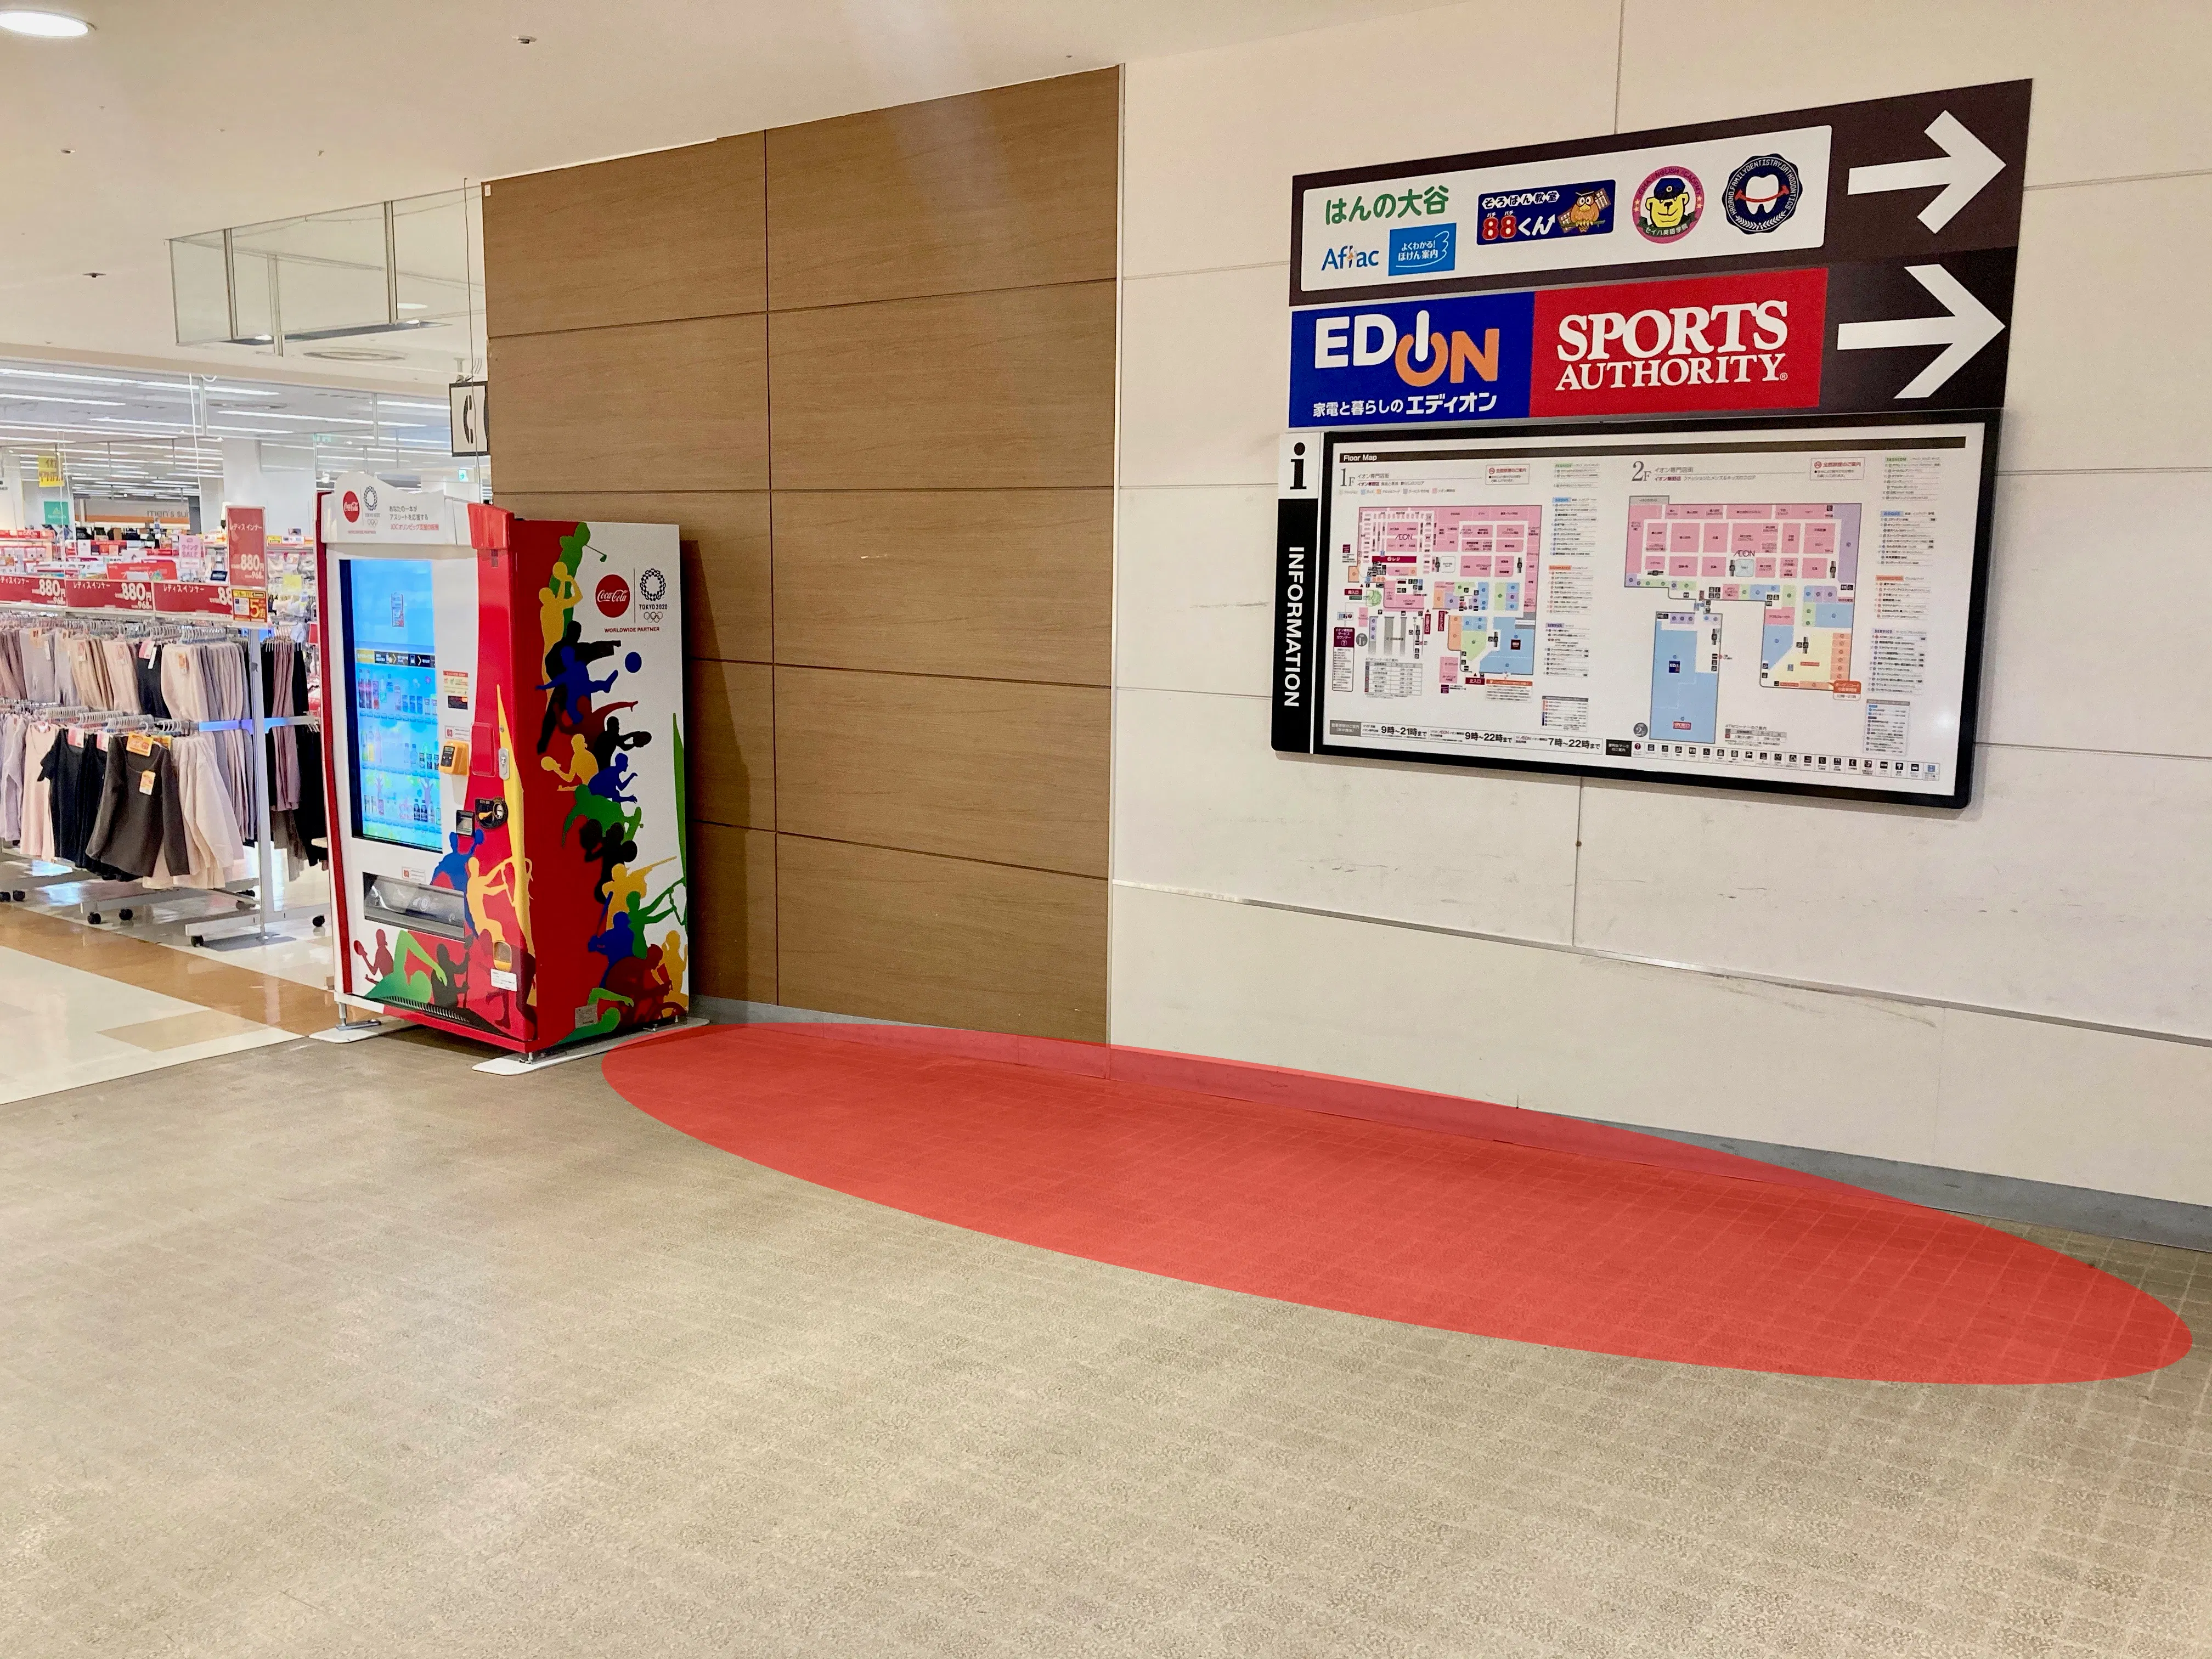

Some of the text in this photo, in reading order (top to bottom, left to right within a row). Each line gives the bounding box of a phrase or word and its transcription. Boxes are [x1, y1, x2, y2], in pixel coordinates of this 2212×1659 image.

[1325, 185, 1449, 225] はんの大谷
[1484, 192, 1558, 208] そろばん教室
[1321, 245, 1379, 271] Aflac
[1398, 249, 1438, 262] ほけん案内
[1557, 300, 1788, 362] SPORTS
[1314, 310, 1500, 387] EDION
[1340, 468, 1356, 487] 1F
[1632, 461, 1652, 481] 2F
[147, 510, 174, 518] men's
[240, 553, 264, 572] 880円
[39, 579, 66, 597] 880円
[121, 583, 152, 601] 880円
[163, 584, 205, 593] レディスインナー
[597, 589, 628, 602] Coca-Cola
[1284, 546, 1305, 707] INFORMATION
